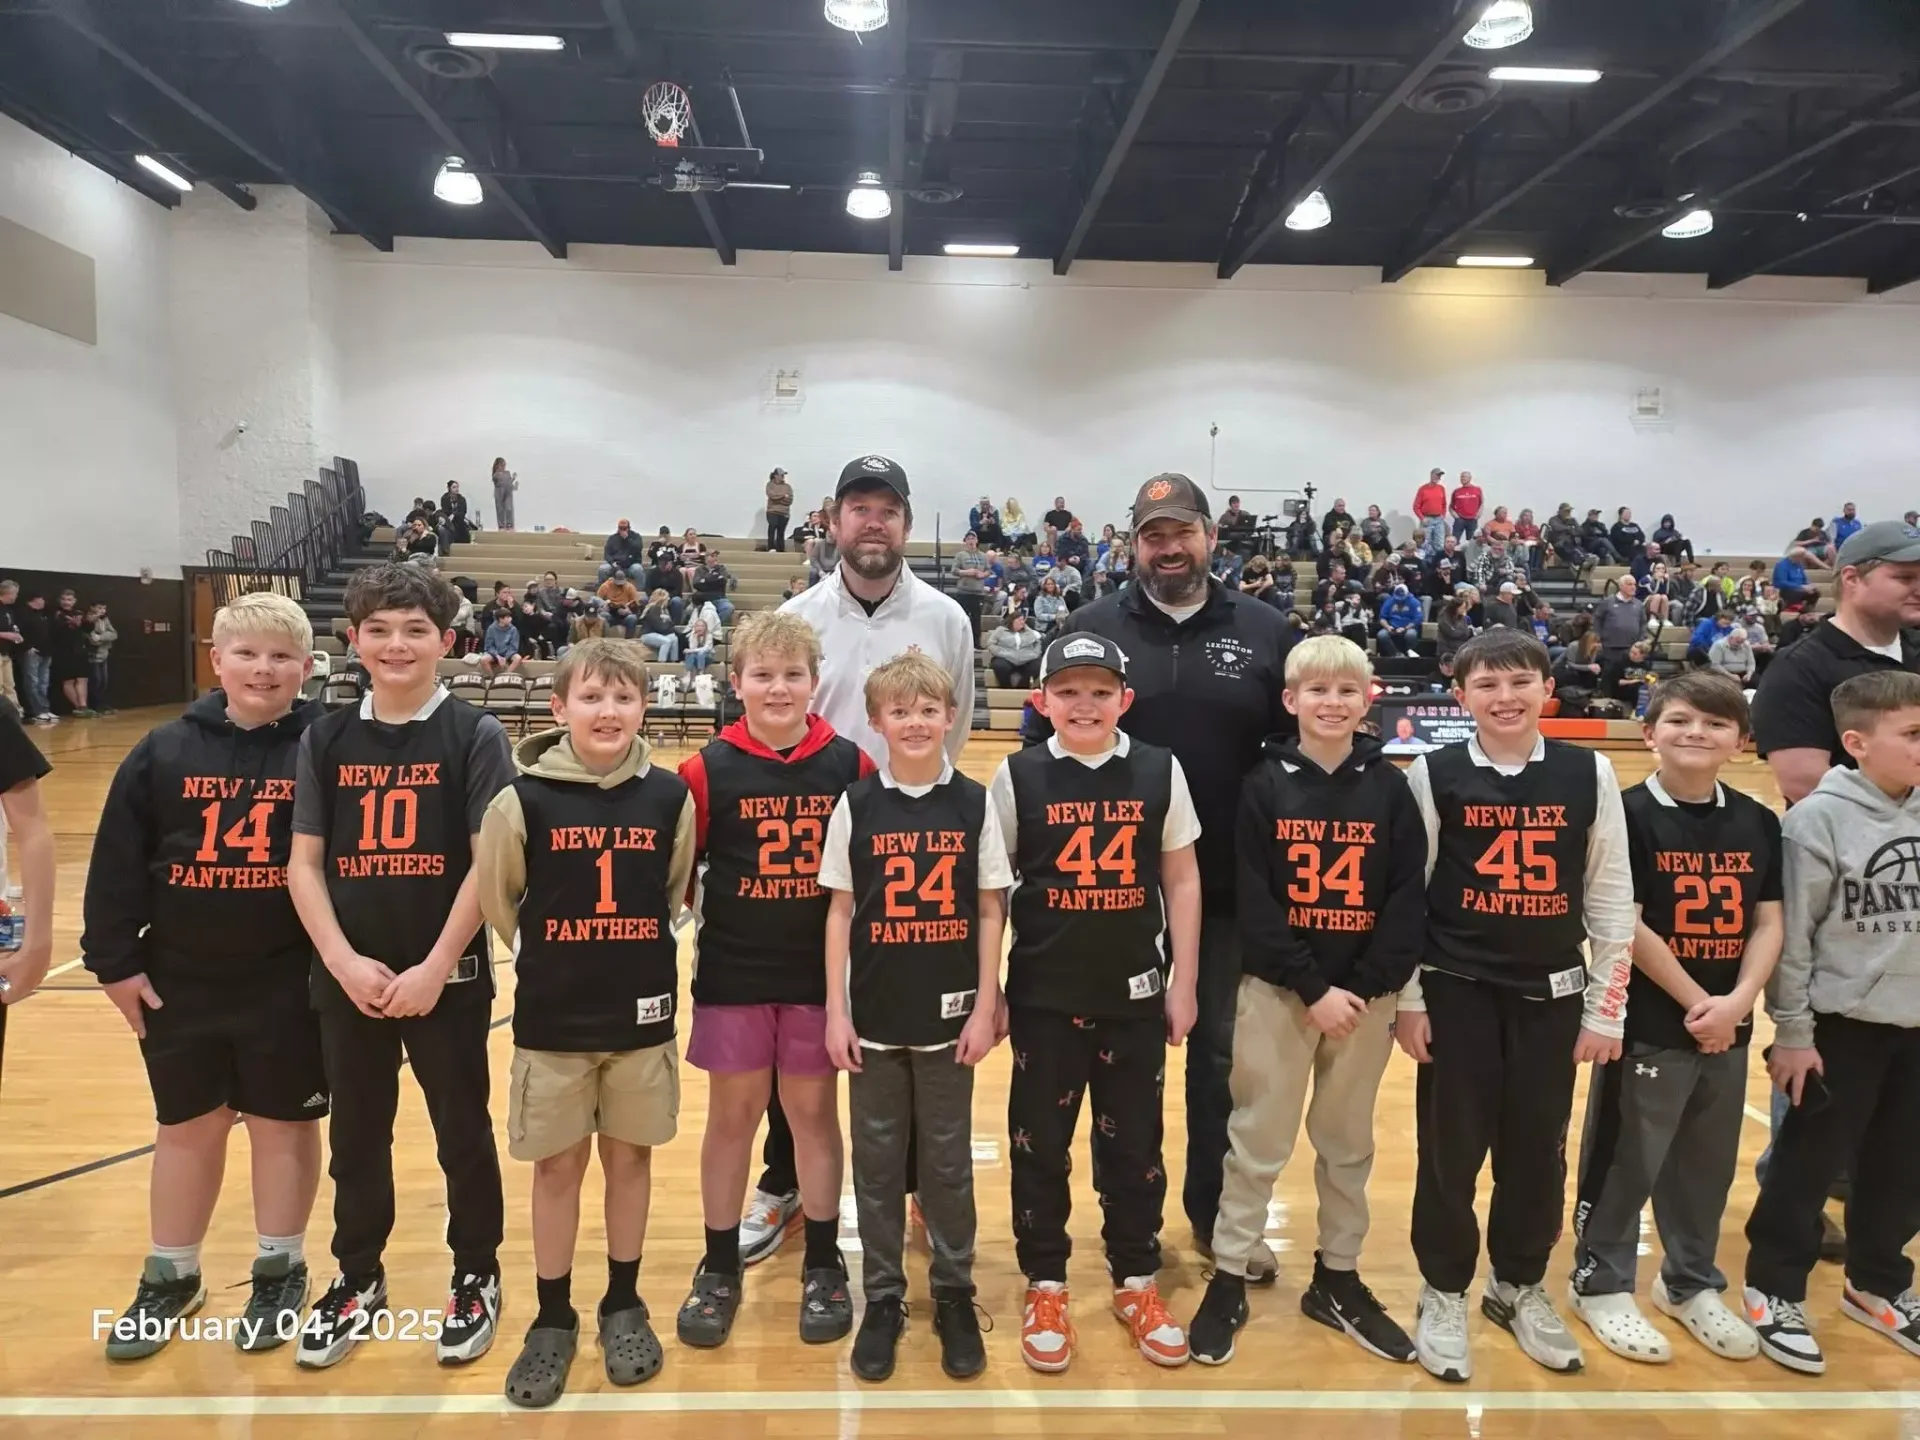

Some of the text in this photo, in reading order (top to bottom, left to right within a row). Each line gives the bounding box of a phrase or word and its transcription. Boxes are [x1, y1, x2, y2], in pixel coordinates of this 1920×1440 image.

[1206, 642, 1252, 654] LEXINGTON
[1221, 637, 1239, 645] NEW
[339, 764, 440, 787] NEW LEX
[183, 777, 243, 799] NEW
[740, 795, 835, 819] NEW LEX
[1047, 800, 1144, 825] NEW LEX
[1464, 805, 1567, 827] NEW LEX
[195, 801, 275, 863] 14
[358, 789, 418, 851] 10
[1276, 819, 1376, 844] NEW LEX
[551, 827, 656, 850] NEW LEX
[757, 818, 823, 875] 23
[872, 831, 966, 855] NEW LEX
[337, 854, 445, 877] PANTHERS
[1055, 825, 1138, 886] 44
[1475, 830, 1557, 892] 45
[1656, 852, 1754, 873] NEW LEX
[595, 850, 617, 914] 1
[884, 855, 957, 918] 24
[1288, 843, 1365, 906] 34
[738, 876, 826, 899] PANTHE
[1048, 887, 1144, 911] PANTHERS
[1462, 888, 1568, 917] PANTHERS
[1674, 875, 1744, 935] 23
[545, 918, 659, 941] PANTHERS
[1288, 906, 1376, 931] ANTHERS
[870, 919, 968, 944] PANTHERS
[1665, 936, 1744, 960] ANTHE
